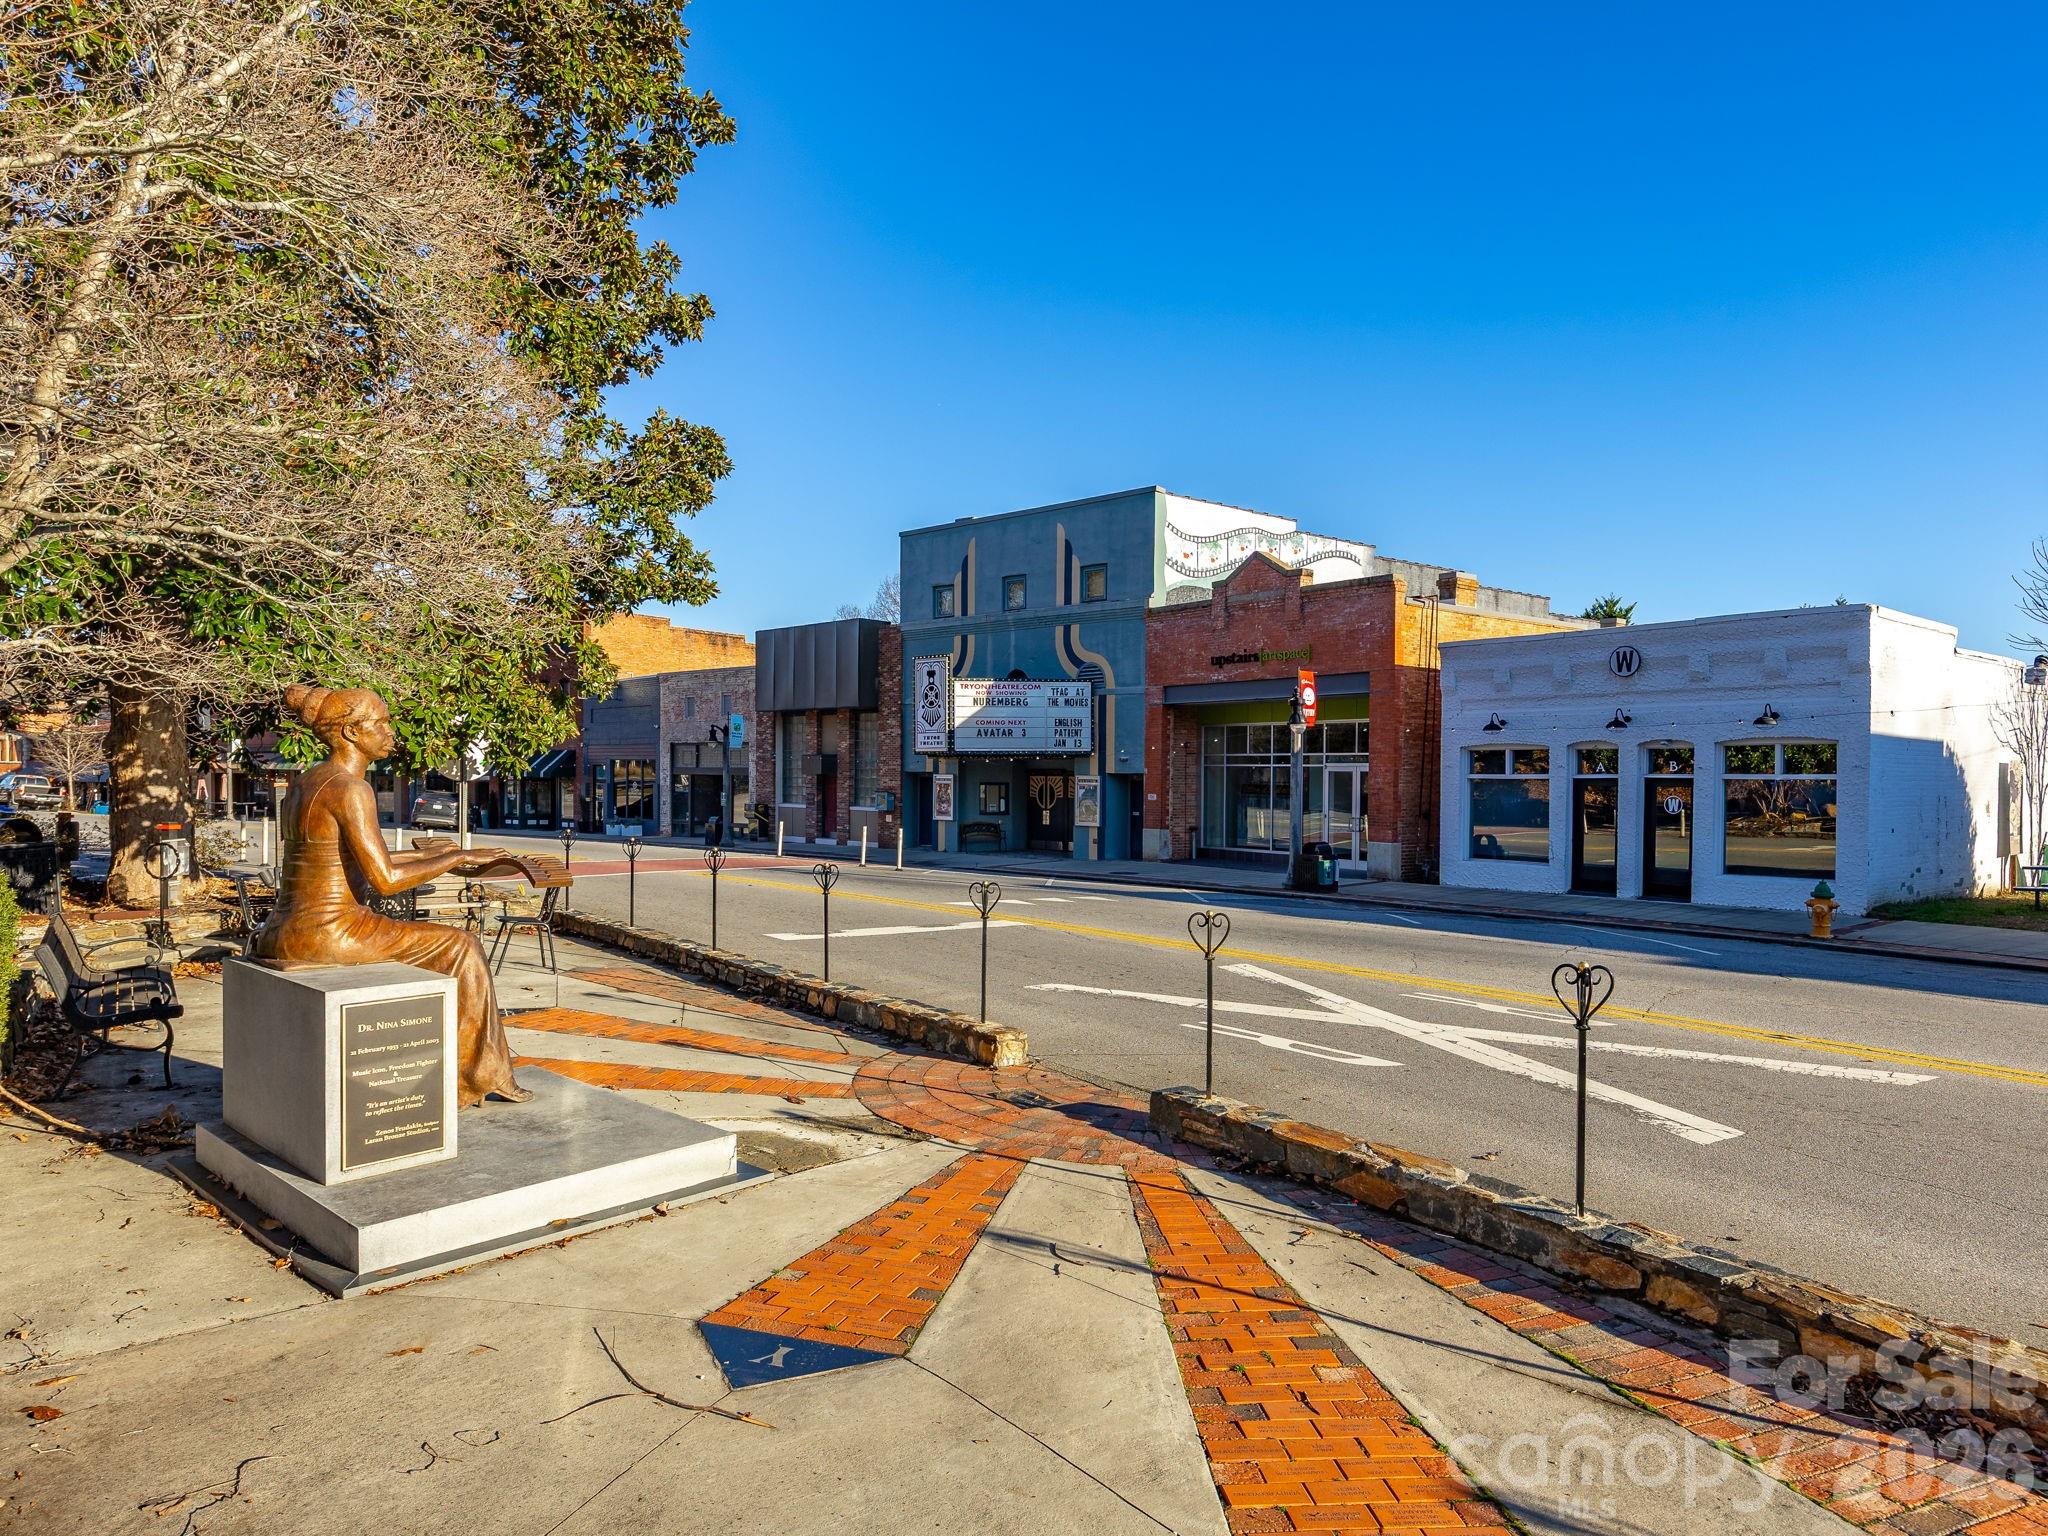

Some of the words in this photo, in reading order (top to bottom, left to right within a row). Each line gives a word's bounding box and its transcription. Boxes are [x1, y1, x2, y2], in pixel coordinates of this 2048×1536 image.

[1616, 650, 1634, 673] W
[1076, 688, 1085, 696] AT
[973, 697, 1028, 706] NUREMBERG
[1048, 698, 1059, 706] THE
[1064, 698, 1088, 706] MOVIES
[1054, 719, 1082, 727] ENGLISH
[976, 728, 1013, 737] AVATAR
[1022, 728, 1026, 737] 3
[1054, 729, 1082, 737] PATIENT
[1054, 739, 1066, 747] JAN
[1074, 739, 1082, 748] 13
[1596, 762, 1605, 772] A
[1669, 760, 1678, 772] B
[358, 1045, 386, 1054] February
[410, 1039, 425, 1047] April
[352, 1069, 371, 1077] Music
[389, 1062, 415, 1071] Freedom
[416, 1059, 438, 1067] Fighter
[368, 1078, 395, 1087] National
[396, 1074, 422, 1082] Treasure
[373, 1107, 393, 1116] reflect
[384, 1132, 405, 1141] Bronze
